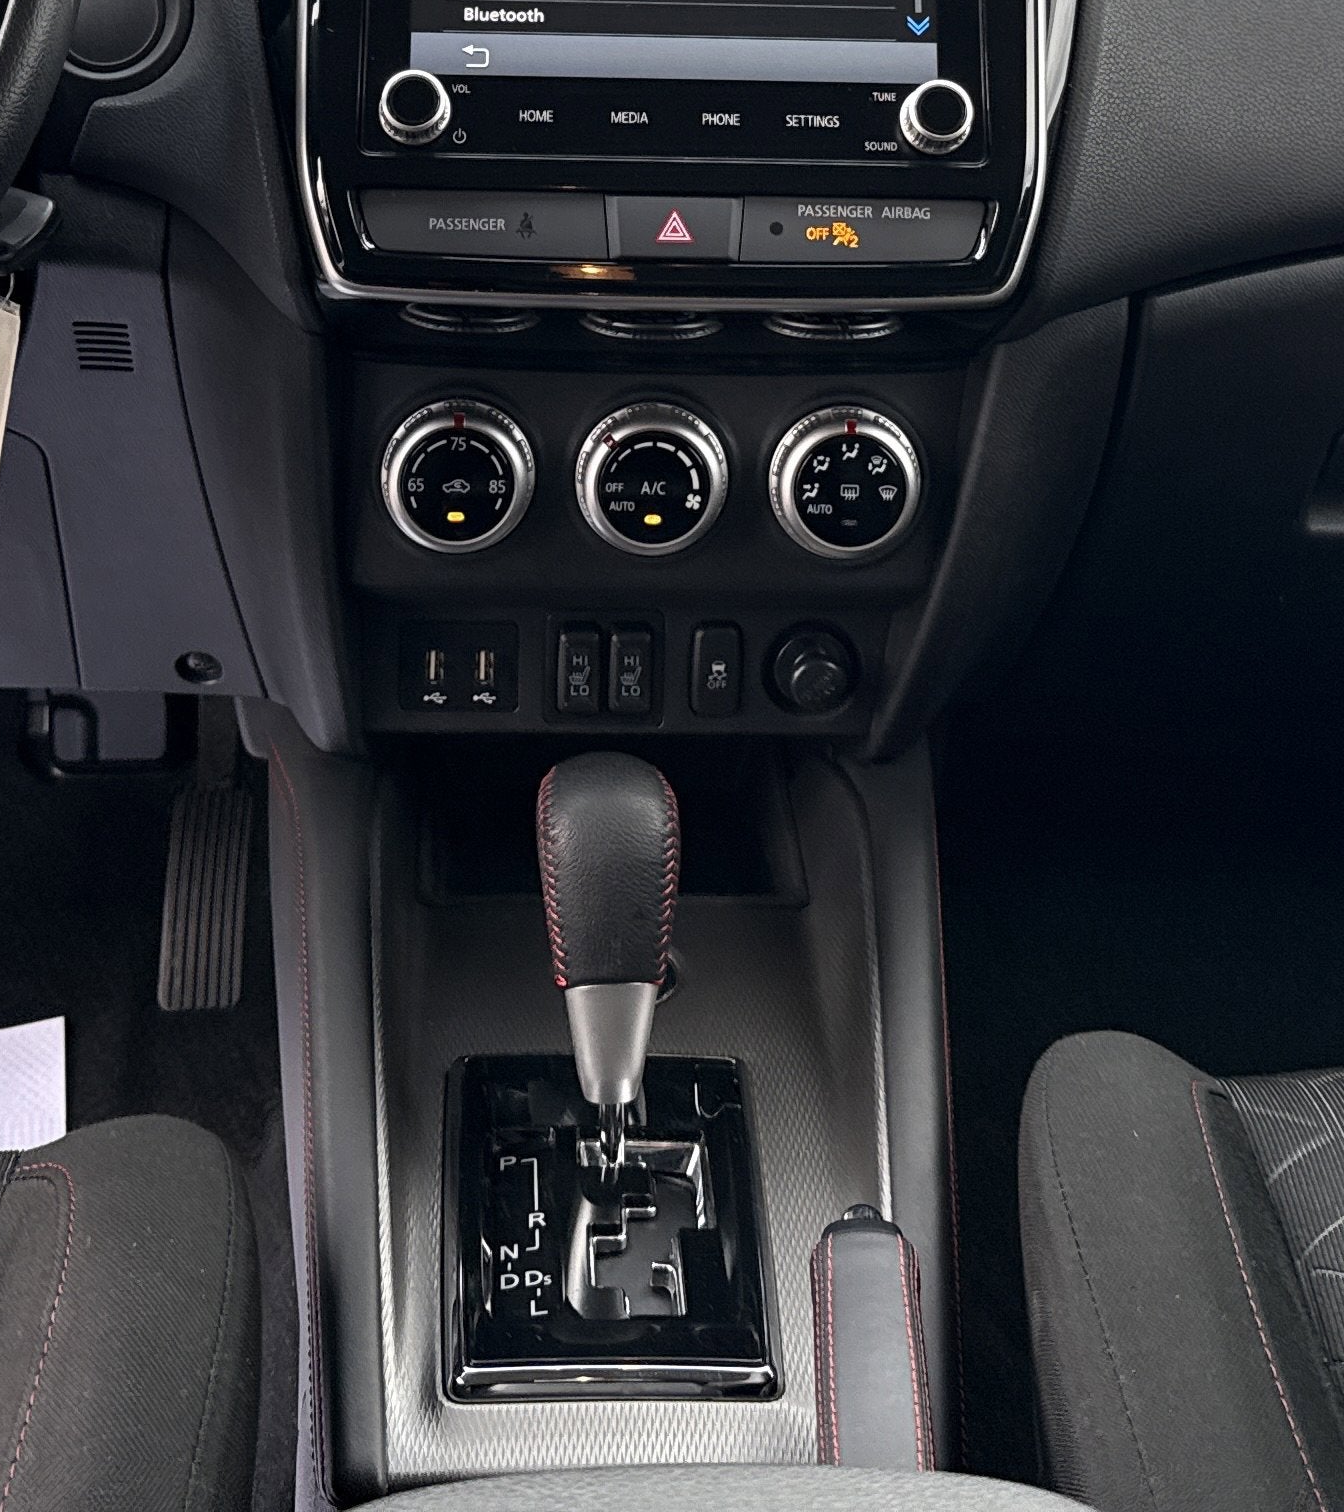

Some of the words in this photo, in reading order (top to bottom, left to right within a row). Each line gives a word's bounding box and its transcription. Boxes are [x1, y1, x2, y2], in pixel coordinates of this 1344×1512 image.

[463, 6, 545, 23] Bluetooth
[451, 83, 471, 94] VOL
[871, 91, 897, 102] TUNE
[518, 109, 554, 124] HOME
[610, 111, 649, 126] MEDIA
[701, 112, 741, 127] PHONE
[785, 114, 840, 129] SETTINGS
[864, 141, 898, 152] SOUND
[797, 204, 873, 219] PASSENGER
[881, 206, 931, 220] AIRBAG
[428, 216, 506, 231] PASSENGER
[805, 226, 830, 241] OFF
[450, 436, 467, 451] 75
[407, 477, 425, 492] 65
[488, 479, 506, 494] 85
[605, 482, 625, 494] OFF
[640, 480, 666, 496] A/C
[608, 500, 636, 512] AUTO
[806, 503, 833, 515] AUTO
[572, 656, 589, 667] HI
[624, 656, 641, 667] HI
[569, 684, 590, 696] LO
[621, 685, 641, 697] LO
[706, 678, 727, 690] OFF
[499, 1155, 517, 1171] P
[528, 1212, 546, 1228] R
[500, 1244, 519, 1260] N
[500, 1274, 520, 1290] D
[530, 1299, 549, 1317] L
